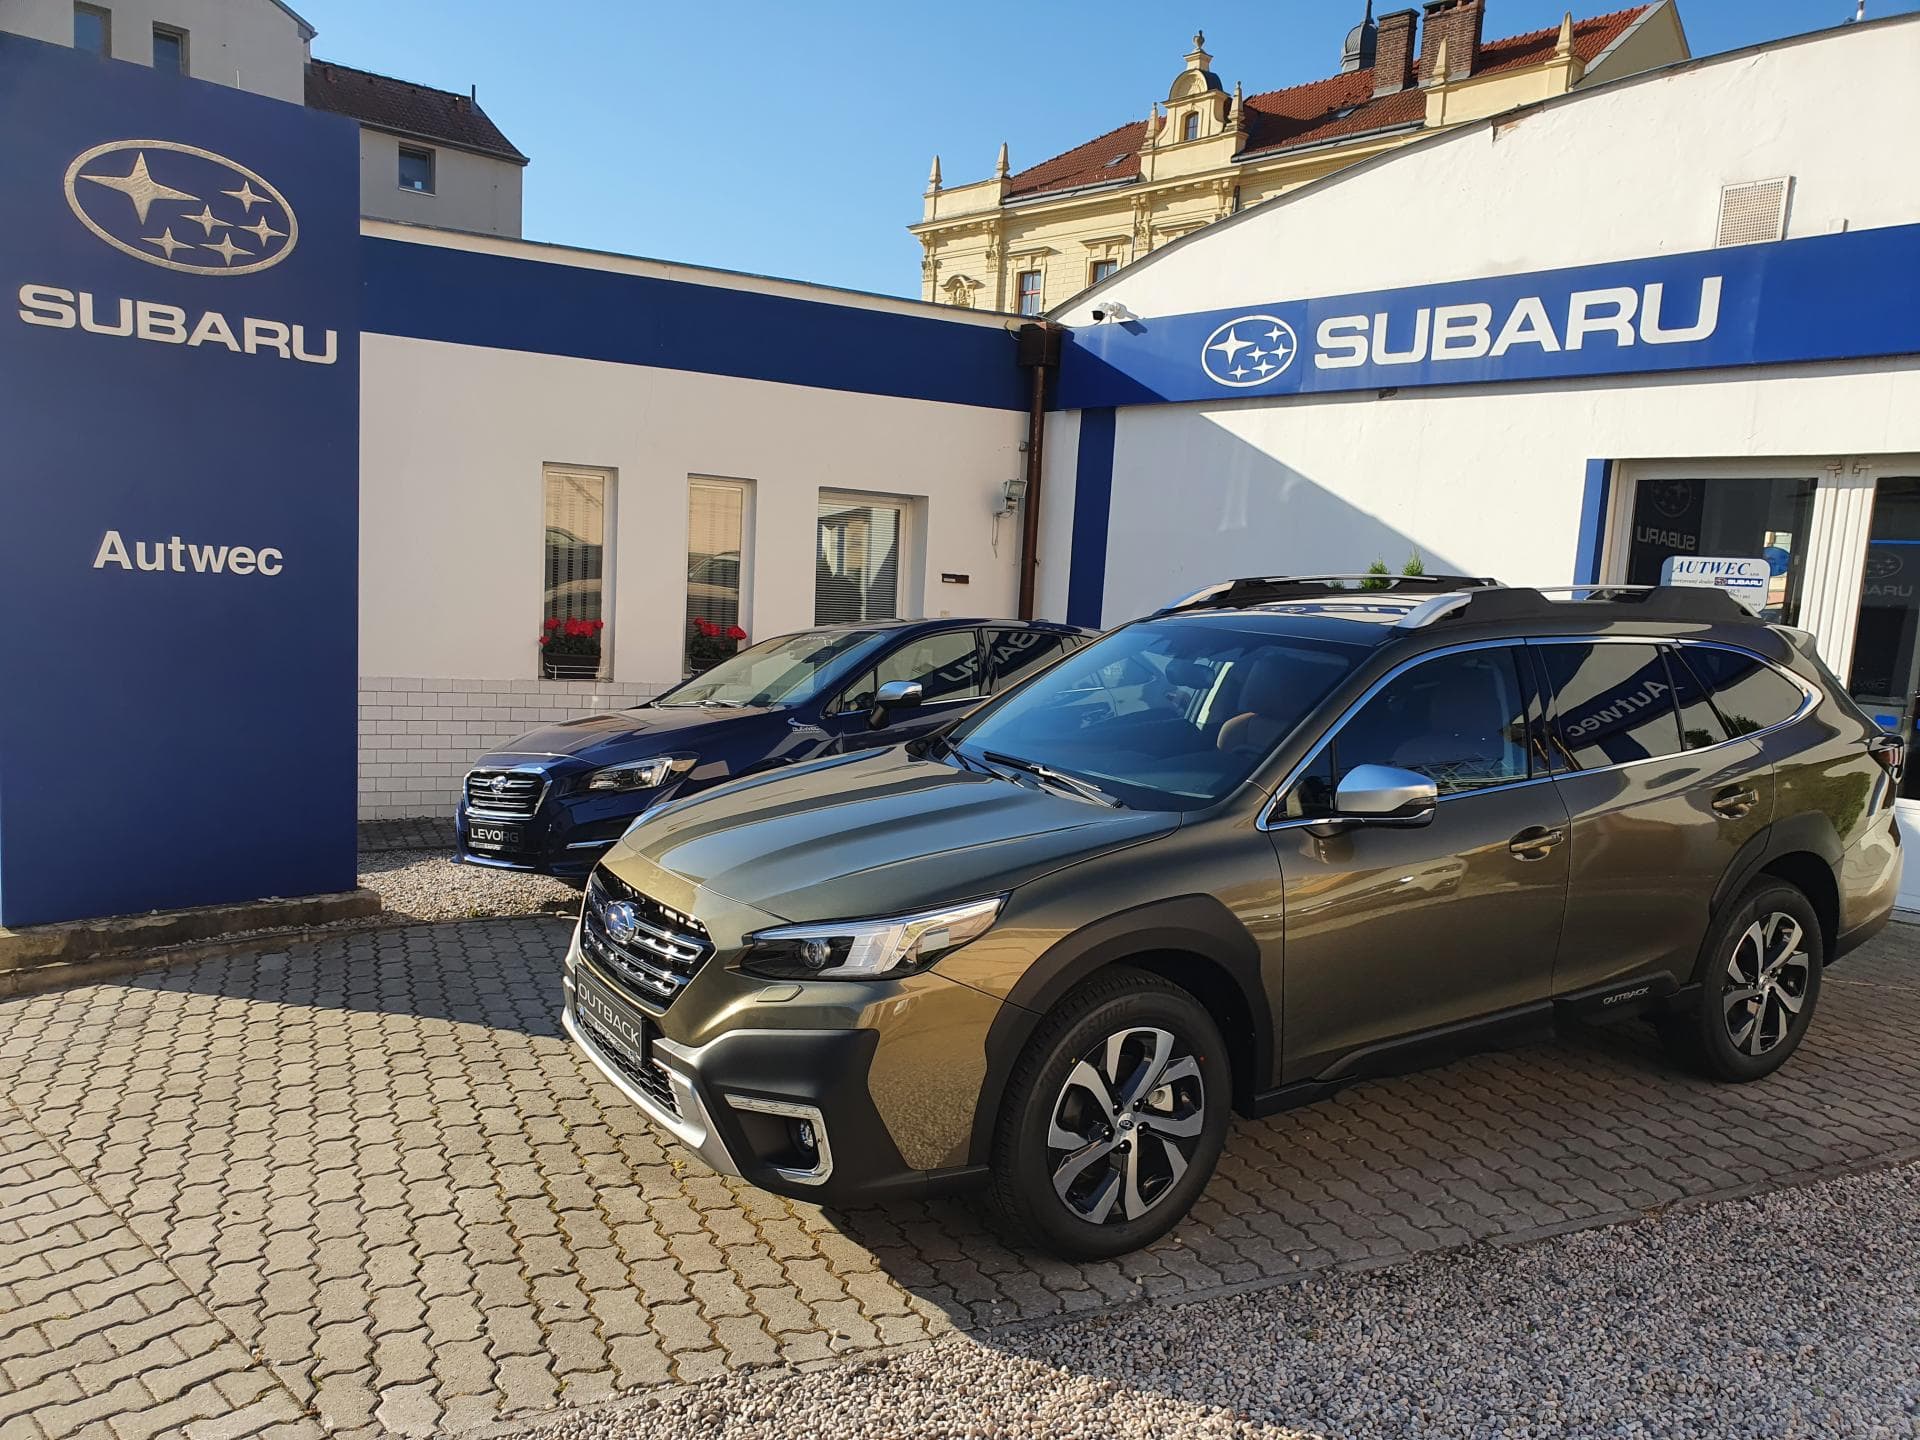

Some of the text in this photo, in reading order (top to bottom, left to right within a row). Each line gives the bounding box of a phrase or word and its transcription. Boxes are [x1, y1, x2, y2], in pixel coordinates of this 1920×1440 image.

[18, 283, 338, 365] SUBARU
[1314, 276, 1723, 370] SUBARU
[93, 530, 283, 576] Autwec
[1672, 561, 1751, 576] AUTWEC
[1863, 584, 1913, 597] ARU
[471, 828, 519, 843] LEVORG
[1603, 986, 1649, 1005] OUTBACK
[578, 983, 639, 1047] OUTBACK
